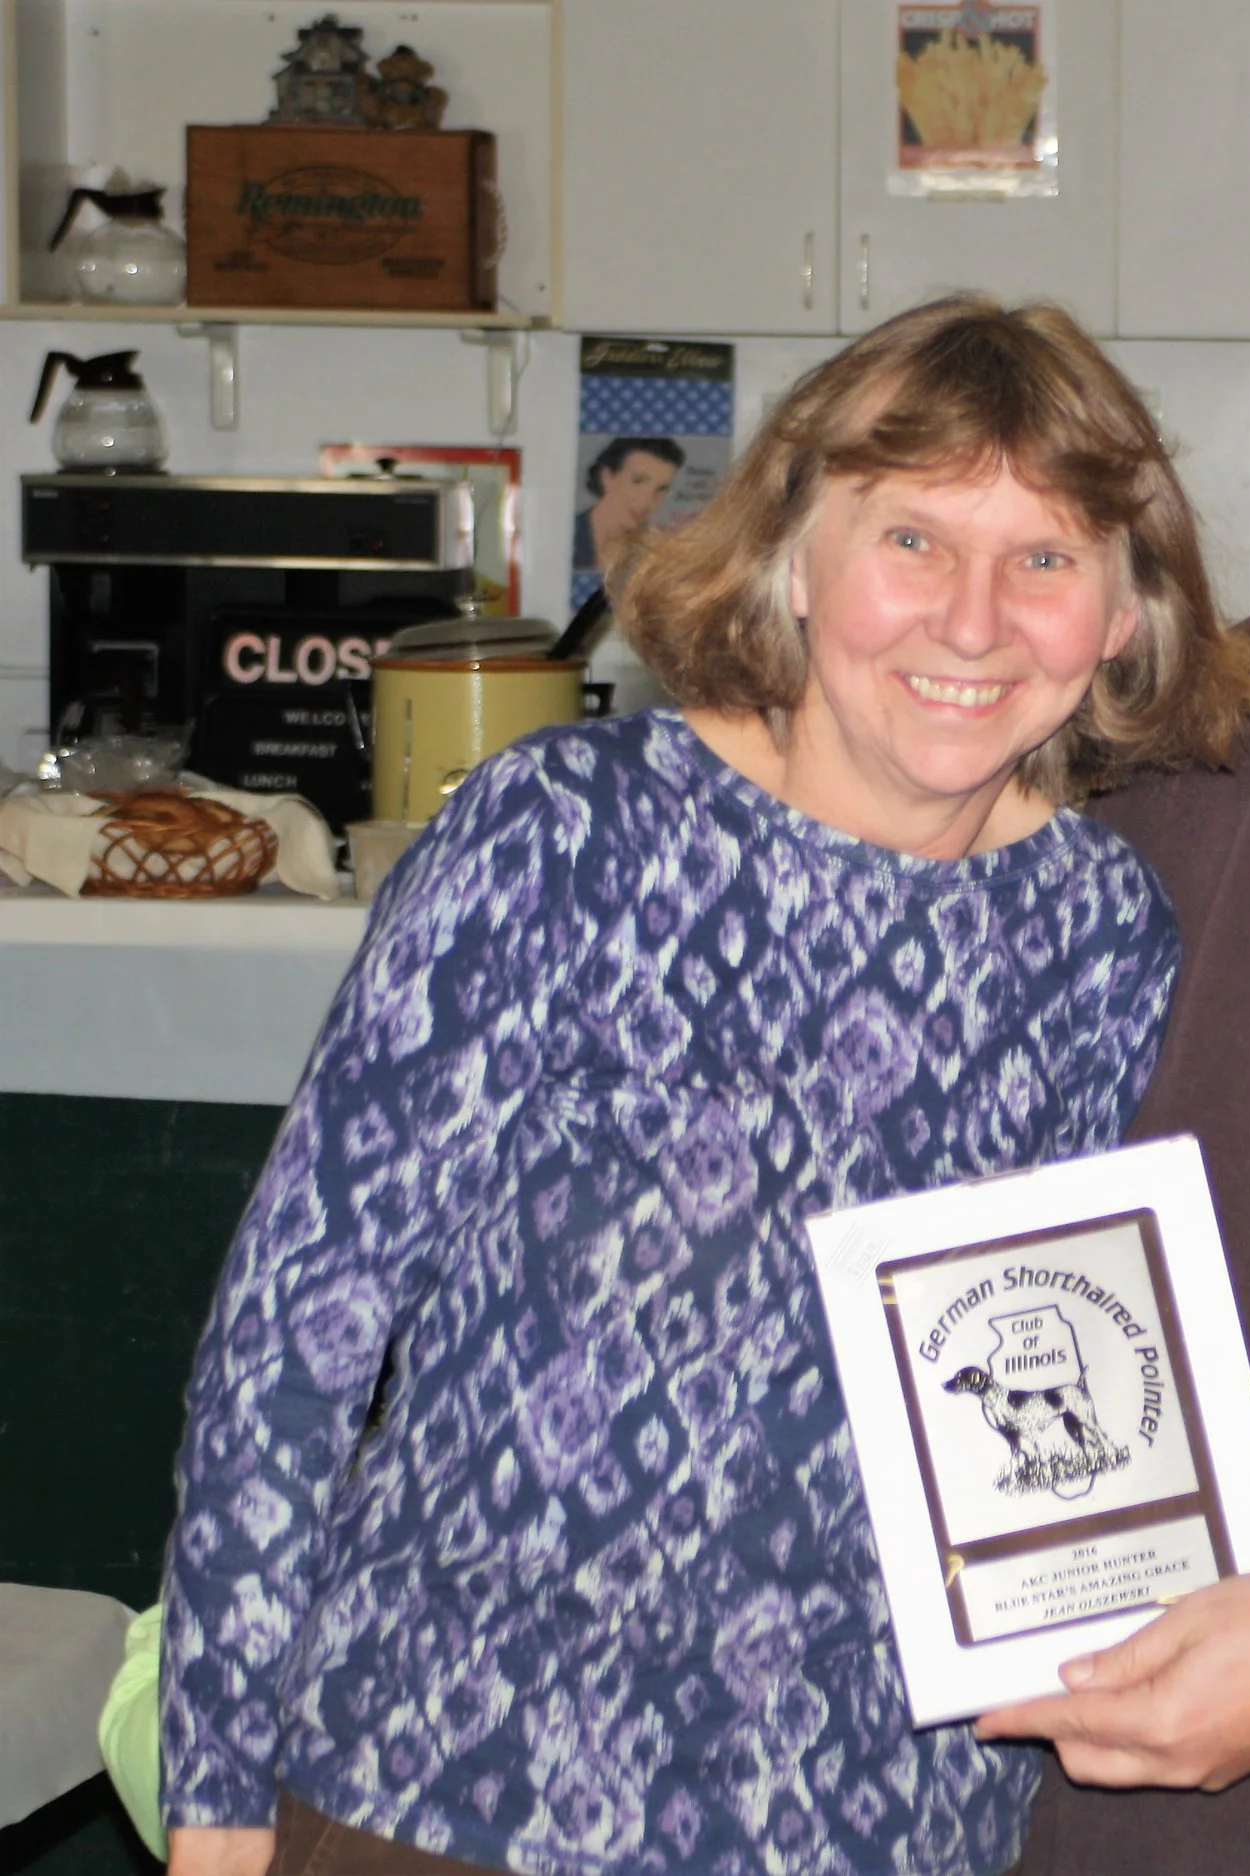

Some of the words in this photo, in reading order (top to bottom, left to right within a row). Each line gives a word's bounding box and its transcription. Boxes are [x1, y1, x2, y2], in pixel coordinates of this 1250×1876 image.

[901, 10, 961, 30] CRISP
[991, 10, 1037, 30] HOT
[252, 741, 338, 758] BREAKFAST
[243, 774, 298, 789] LUNCH
[1011, 1316, 1044, 1335] Club
[1022, 1335, 1040, 1350] of
[919, 1279, 996, 1364] German
[1003, 1265, 1147, 1340] Shorthaired
[1134, 1346, 1165, 1448] Pointer
[1005, 1348, 1067, 1374] Illinois
[1072, 1546, 1099, 1560] 2016
[1021, 1573, 1048, 1590] AKC
[1051, 1562, 1100, 1583] JUNIOR
[1103, 1550, 1157, 1571] HUNTER
[994, 1596, 1029, 1613] BLUE
[1031, 1586, 1077, 1606] STAR'S
[1079, 1571, 1142, 1595] AMAZING
[1144, 1559, 1190, 1579] GRACE
[1043, 1603, 1075, 1619] JEAN
